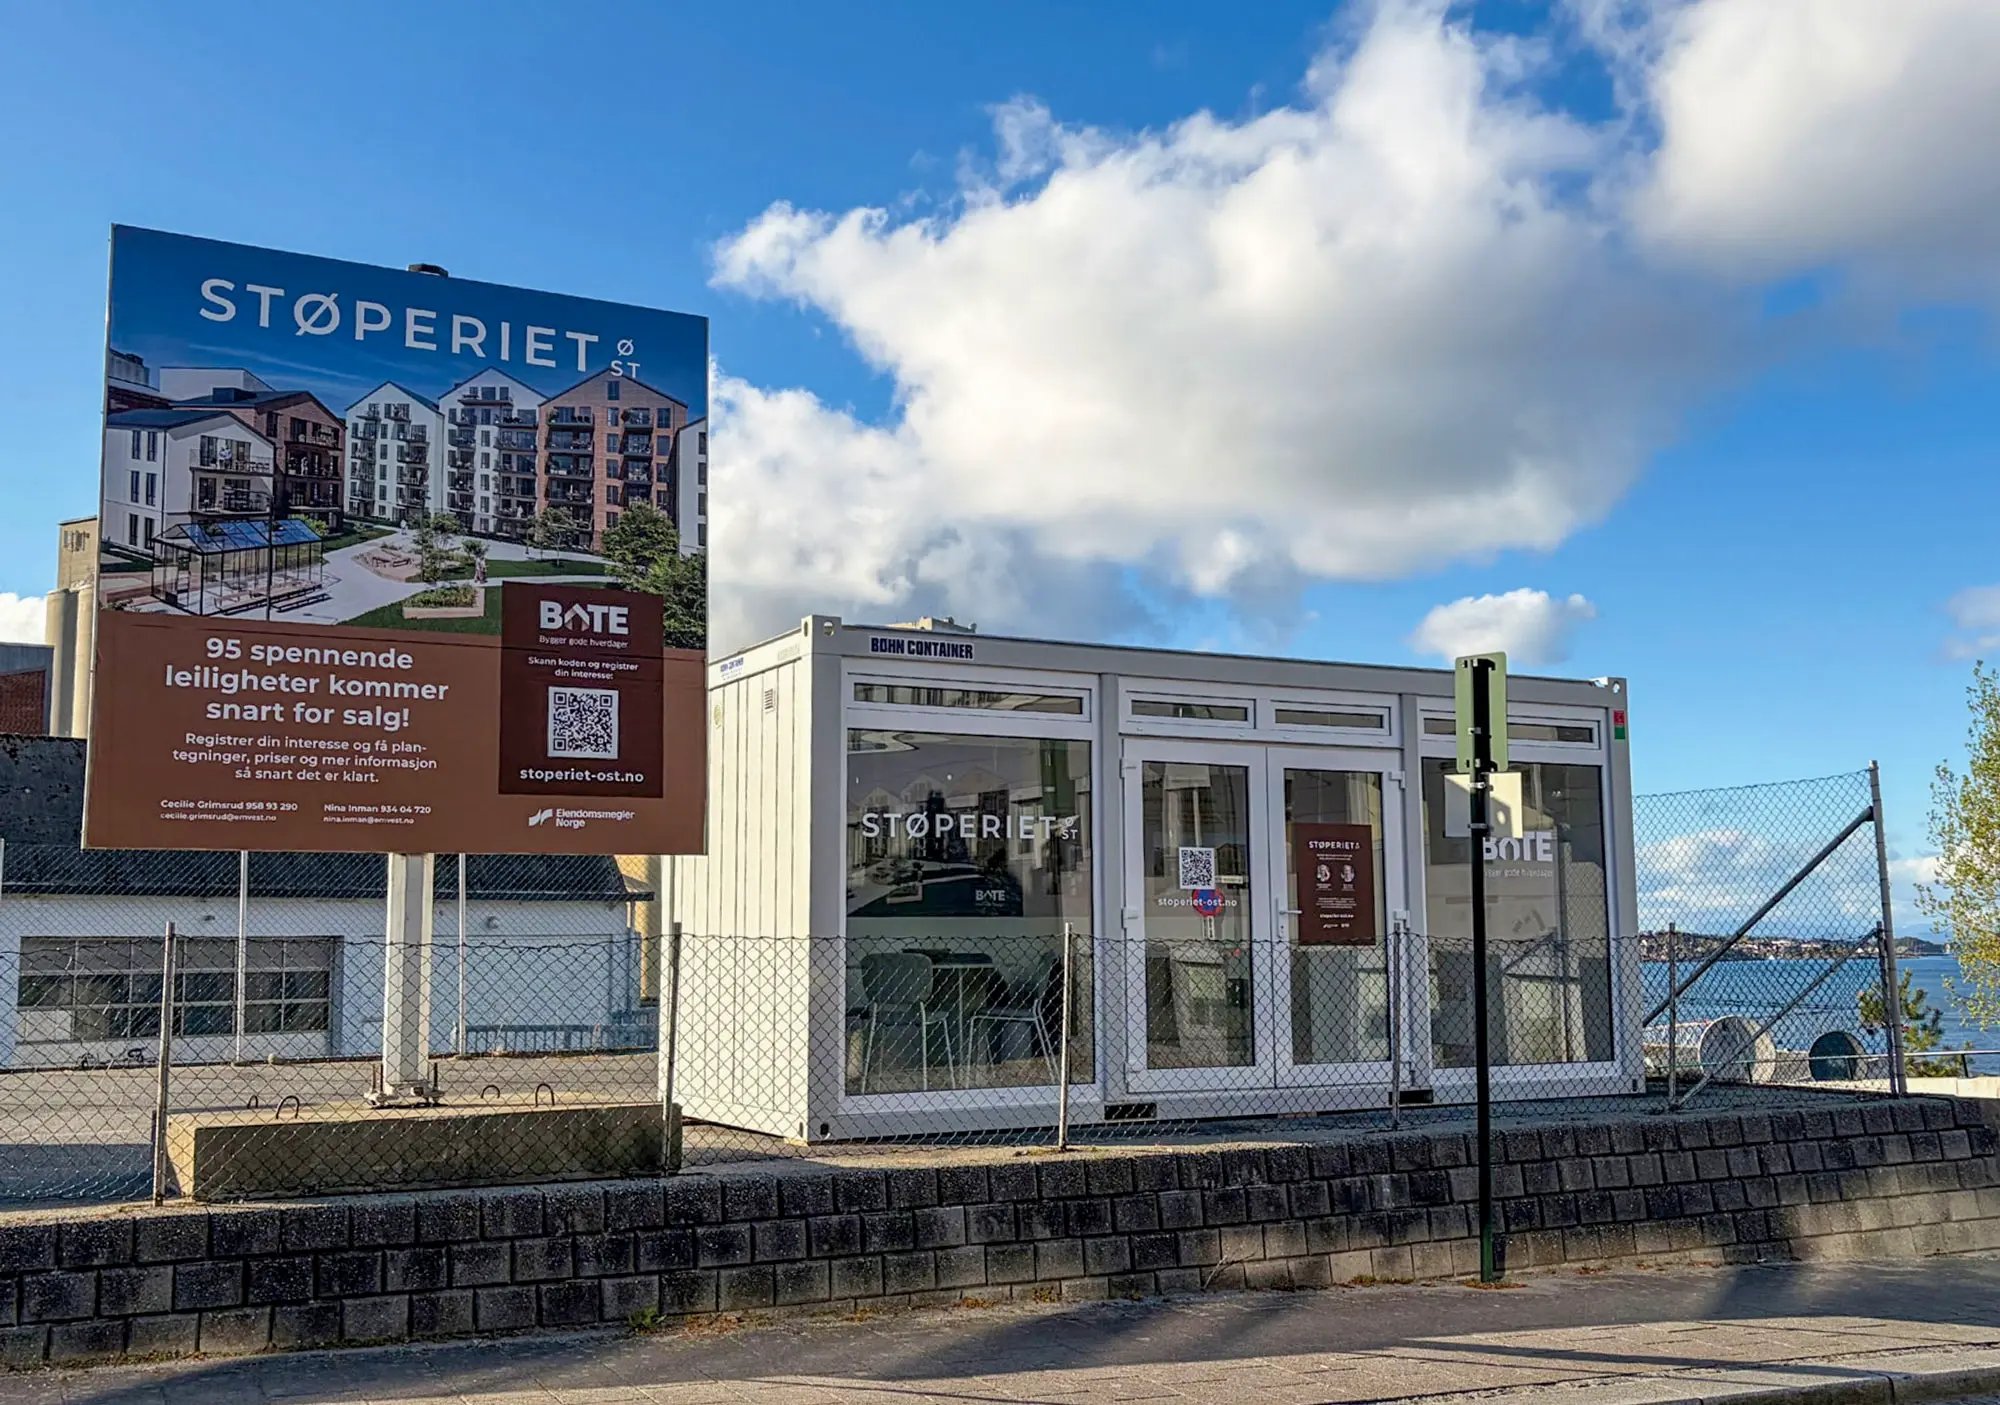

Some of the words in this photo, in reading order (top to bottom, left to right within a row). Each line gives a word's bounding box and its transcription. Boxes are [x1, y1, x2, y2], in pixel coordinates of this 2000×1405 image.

[199, 277, 599, 374] STØPERIET
[610, 359, 641, 378] ST
[539, 635, 567, 645] Bygger
[569, 637, 588, 646] gode
[589, 638, 629, 649] hverdager
[907, 640, 973, 660] CONTAINER
[206, 637, 241, 660] 95
[250, 642, 414, 670] spennende
[528, 656, 557, 667] Skann
[558, 658, 587, 668] koden
[588, 661, 600, 670] og
[601, 661, 639, 672] registrer
[165, 665, 320, 695] leiligheter
[329, 674, 449, 700] kommer
[555, 668, 570, 677] din
[571, 669, 614, 680] interesse:
[206, 701, 284, 723] snart
[293, 702, 335, 725] for
[342, 706, 410, 732] salg!
[185, 733, 254, 749] Registrer
[257, 735, 280, 748] din
[284, 736, 350, 750] interesse
[353, 740, 371, 754] og
[374, 738, 388, 752] få
[391, 740, 427, 755] plan-
[172, 750, 251, 765] tegninger,
[254, 751, 296, 766] priser
[299, 755, 318, 768] og
[322, 756, 351, 767] mer
[354, 754, 438, 770] informasjon
[235, 766, 251, 779] så
[255, 768, 293, 781] snart
[296, 769, 321, 782] det
[324, 772, 339, 783] er
[343, 770, 379, 783] klart.
[520, 768, 644, 783] stoperiet-ost.no
[160, 800, 195, 809] Cecilie
[197, 800, 244, 810] Grimsrud
[246, 802, 264, 810] 958
[266, 802, 278, 810] 93
[280, 802, 298, 811] 290
[324, 804, 346, 813] Nina
[348, 804, 379, 813] Inman
[381, 805, 398, 813] 934
[400, 805, 413, 814] 04
[414, 806, 431, 814] 720
[556, 808, 636, 821] Eiendomsmegler
[556, 817, 586, 829] Norge
[861, 811, 1056, 839] STØPERIET
[1158, 897, 1238, 908] stoperiet-ost.no
